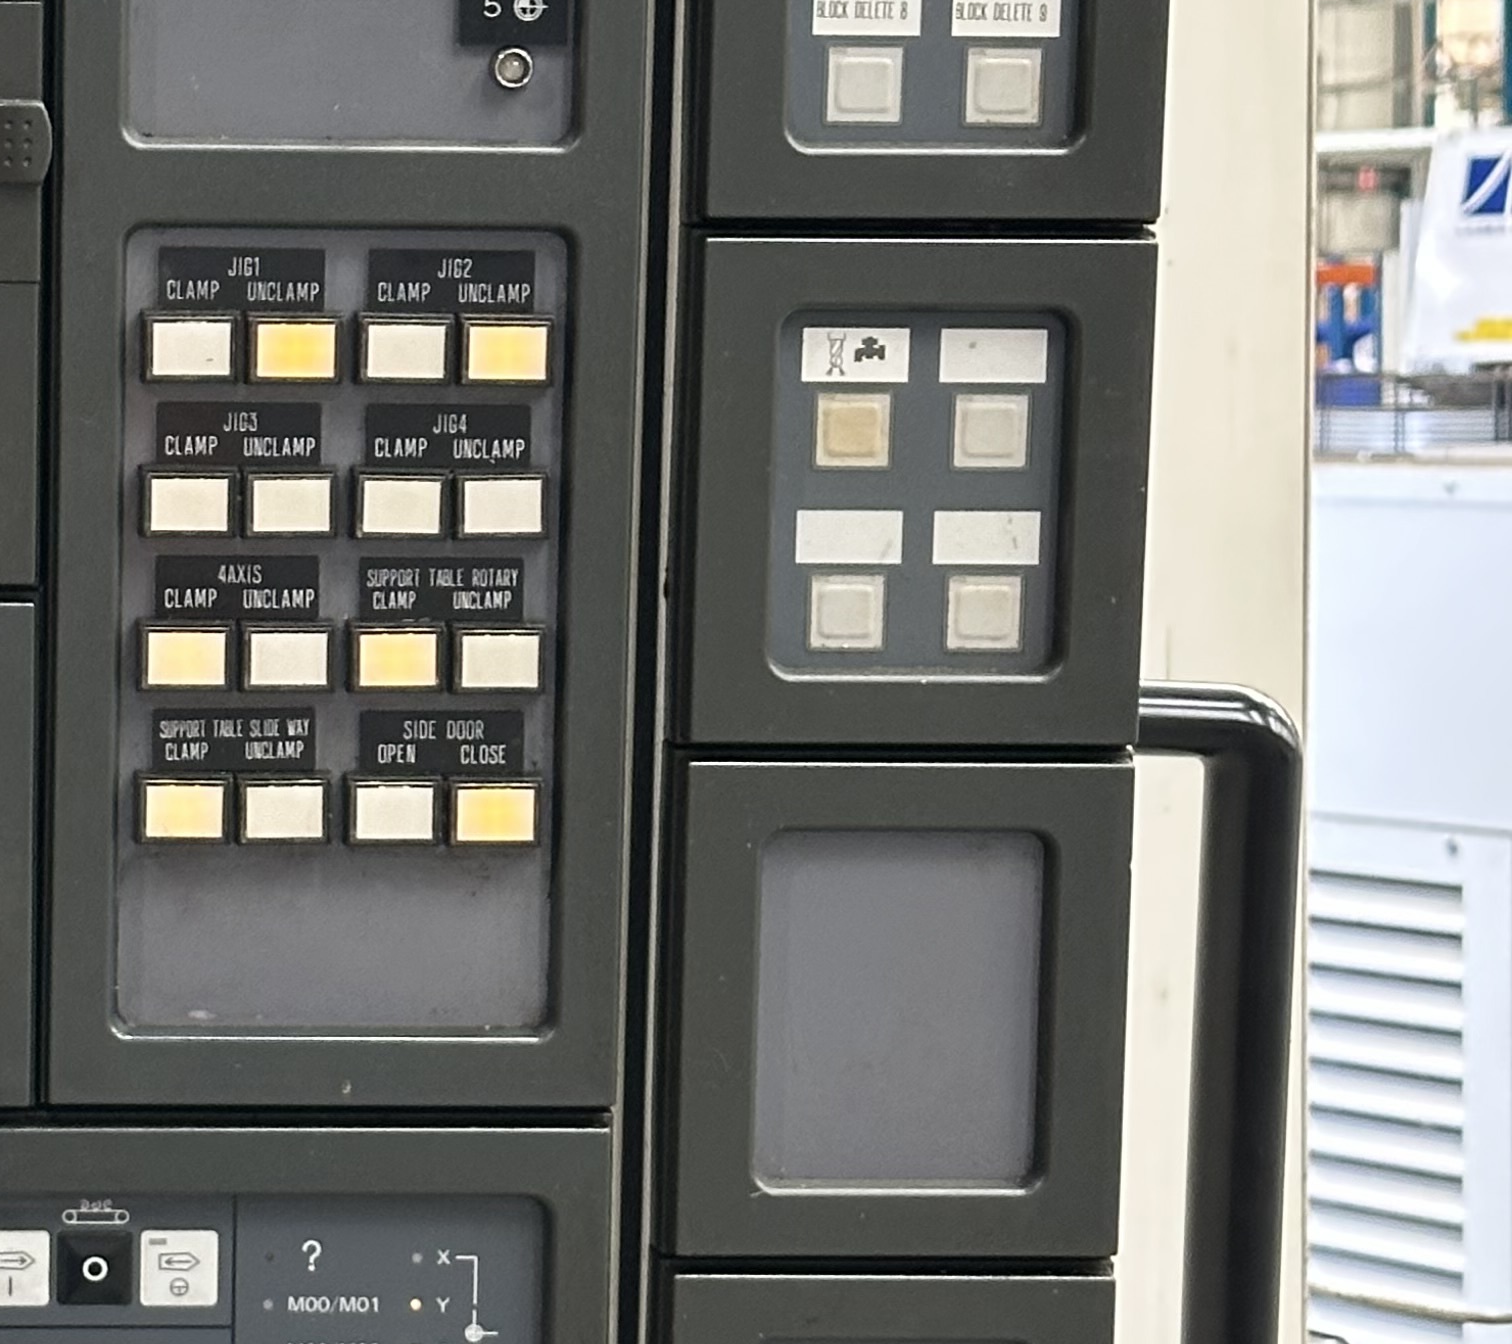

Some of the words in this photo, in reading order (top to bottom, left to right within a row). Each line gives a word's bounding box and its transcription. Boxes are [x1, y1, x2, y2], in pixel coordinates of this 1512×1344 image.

[228, 257, 260, 276] JIG1
[438, 259, 472, 278] JIG2
[167, 281, 220, 299] CLAMP
[247, 282, 319, 301] UNCLAMP
[378, 282, 431, 302] CLAMP
[458, 284, 530, 303] UNCLAMP
[223, 413, 258, 431] JIG3
[433, 415, 467, 433] JIG4
[165, 436, 218, 455] CLAMP
[243, 437, 315, 457] UNCLAMP
[375, 437, 427, 457] CLAMP
[453, 439, 525, 459] UNCLAMP
[218, 565, 262, 583] 4AXIS
[367, 569, 420, 587] SUPPORT
[429, 569, 463, 587] TABLE
[472, 569, 519, 587] ROTARY
[165, 589, 217, 608] CLAMP
[243, 589, 315, 609] UNCLAMP
[373, 591, 416, 609] CLAMP
[453, 592, 512, 609] UNCLAMP
[160, 720, 205, 738] SUPPORT
[213, 719, 242, 737] TABLE
[250, 719, 280, 737] SLIDE
[403, 721, 437, 740] SIDE
[447, 721, 483, 740] DOOR
[165, 743, 208, 761] CLAMP
[245, 743, 304, 760] UNCLAMP
[378, 744, 416, 764] OPEN
[460, 745, 505, 764] CLOSE
[288, 1296, 379, 1312] M00/M01
